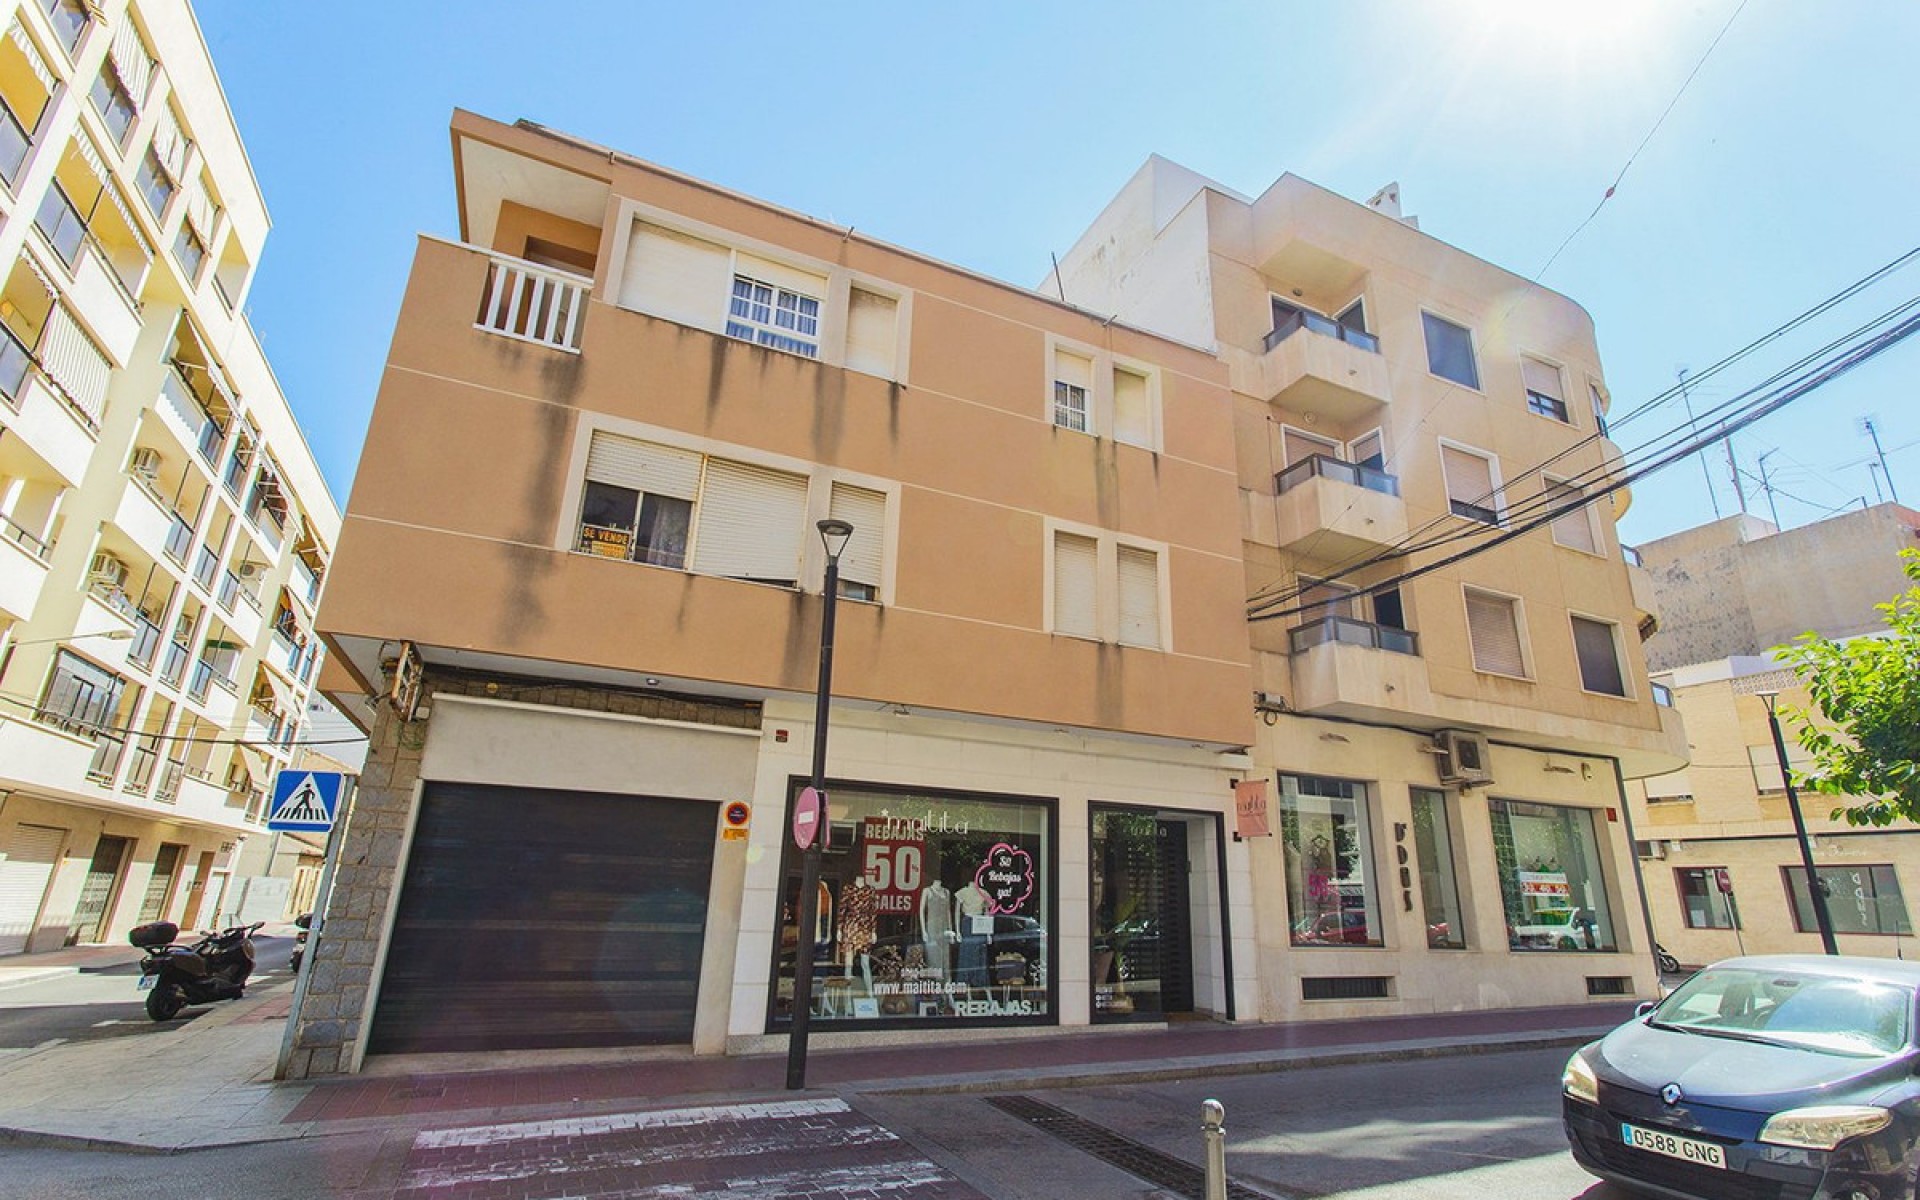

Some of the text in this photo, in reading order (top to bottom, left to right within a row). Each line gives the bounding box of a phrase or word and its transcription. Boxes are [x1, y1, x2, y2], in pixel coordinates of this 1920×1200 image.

[583, 527, 628, 545] SE VENDE
[865, 823, 924, 841] REBAJAS
[865, 844, 921, 892] 50
[873, 980, 968, 996] www.maitita.com
[954, 999, 1032, 1017] REBAJAS
[1634, 1129, 1720, 1165] 0588 GNG
